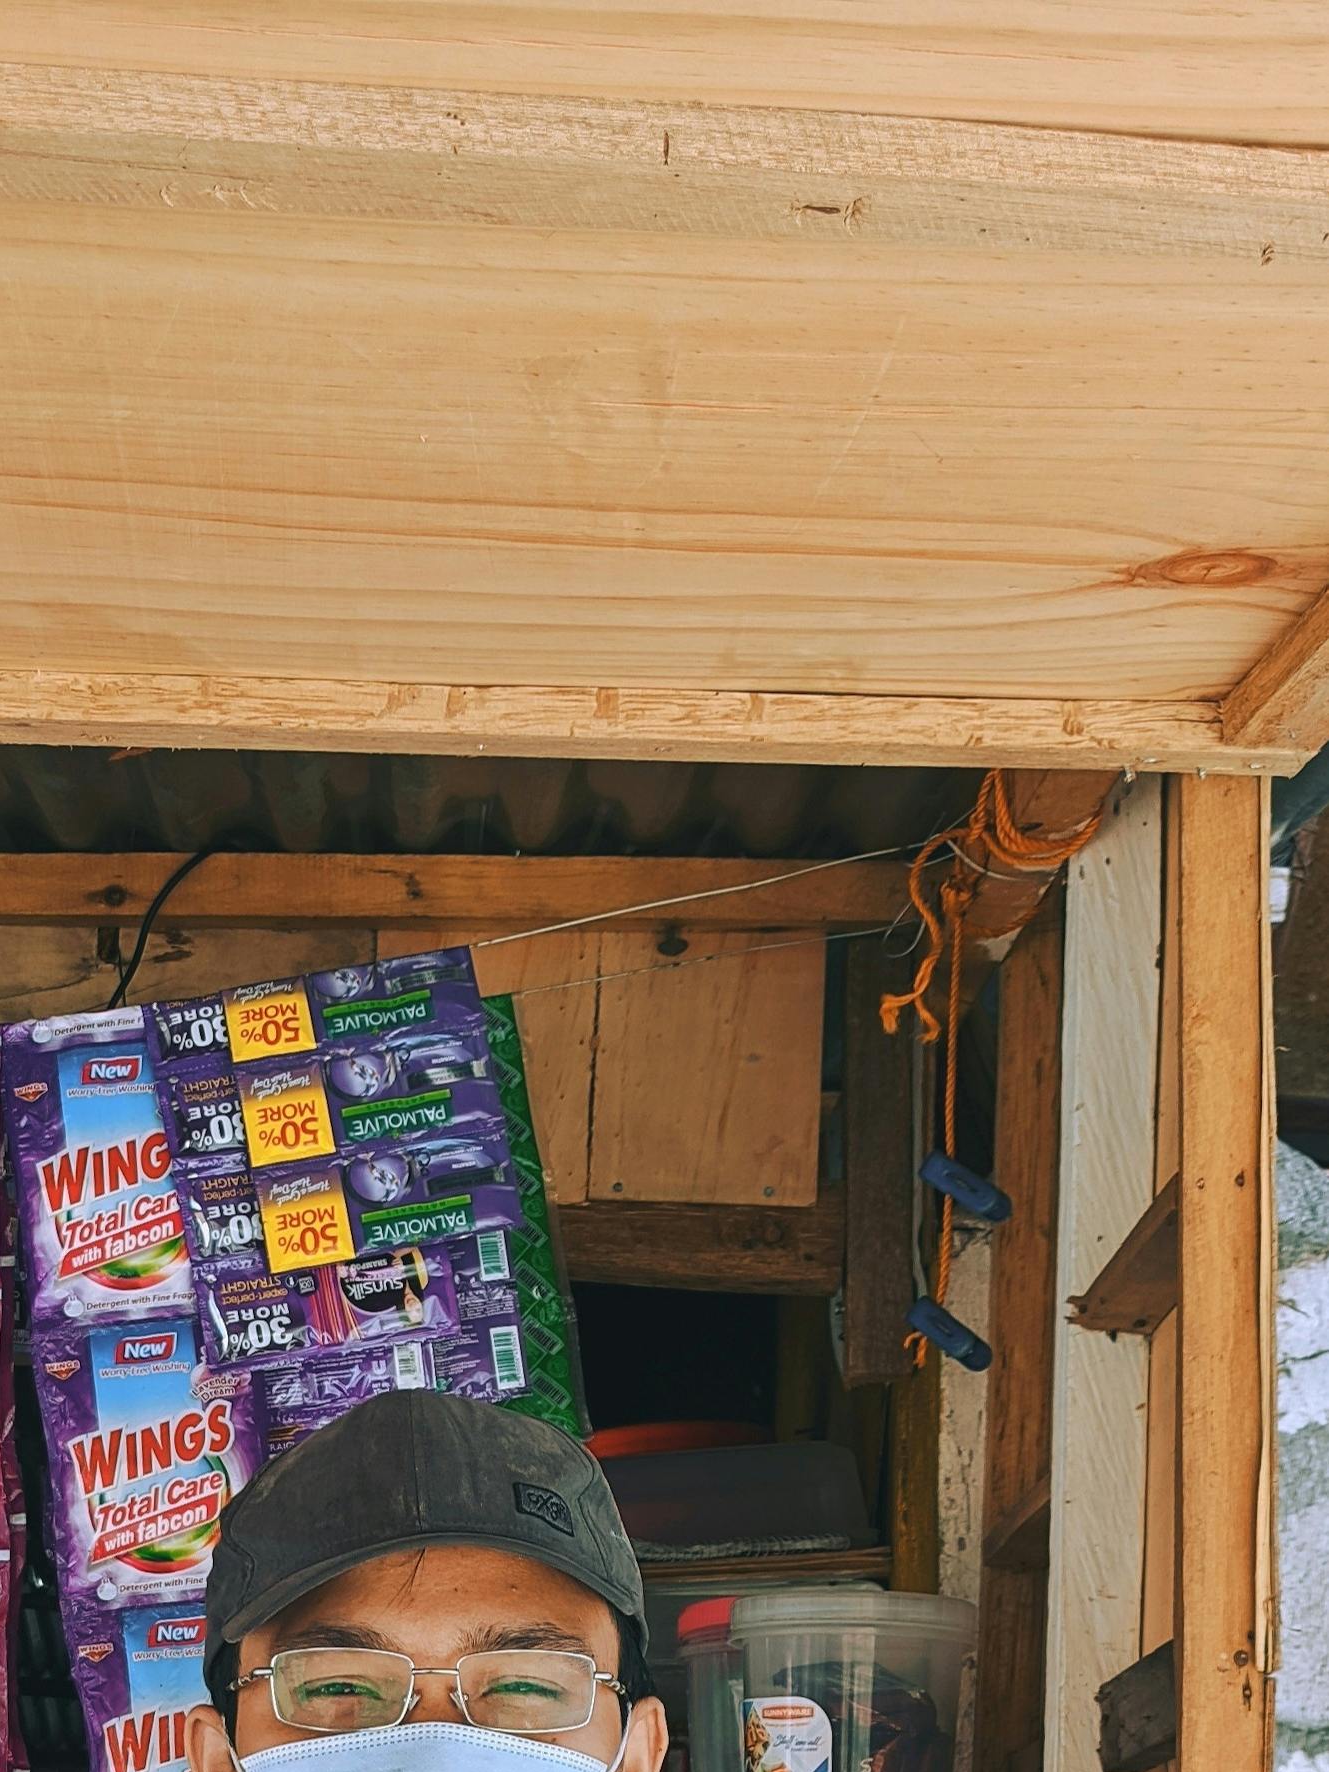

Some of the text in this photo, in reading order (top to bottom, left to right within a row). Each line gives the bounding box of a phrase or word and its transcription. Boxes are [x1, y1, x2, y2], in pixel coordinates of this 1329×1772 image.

[233, 982, 274, 1000] Hair Day!
[273, 983, 294, 993] Have
[238, 1002, 298, 1026] MORE
[332, 1002, 427, 1034] PALMOLIVE
[54, 1018, 137, 1037] Detergent with Fine
[240, 1016, 301, 1046] 50%
[90, 1063, 133, 1080] New
[289, 1075, 311, 1086] Have
[14, 1083, 48, 1095] WINGS
[67, 1083, 157, 1098] Worry-Free Washing
[183, 1075, 237, 1093] TRAIGHT
[250, 1072, 292, 1095] Hair Day!
[256, 1100, 315, 1125] MORE
[352, 1104, 447, 1137] PALMOLIVE
[259, 1117, 320, 1149] 50%
[40, 1130, 172, 1214] WING
[64, 1192, 180, 1246] Total Car
[275, 1205, 335, 1232] MORE
[371, 1210, 468, 1242] PALMOLIVE
[71, 1220, 175, 1268] with fabcon
[278, 1222, 339, 1256] 50%
[220, 1275, 282, 1295] STRAIGHT
[86, 1292, 172, 1311] Detergent with Fine
[221, 1289, 289, 1306] expert-perfect
[226, 1302, 290, 1325] MORE
[229, 1315, 293, 1351] 30%
[123, 1340, 167, 1359] New
[45, 1361, 80, 1371] WINGS
[100, 1362, 191, 1378] Worry-Free Washing
[192, 1376, 240, 1397] Lavender
[201, 1384, 236, 1402] Dream
[72, 1402, 232, 1496] WINGS
[95, 1471, 223, 1530] Total Care
[104, 1504, 208, 1553] with fabcon
[119, 1576, 204, 1593] Detergent with Fine
[156, 1624, 198, 1642] New
[132, 1649, 184, 1661] Worry-Free
[763, 1707, 813, 1718] SUNNYWARE
